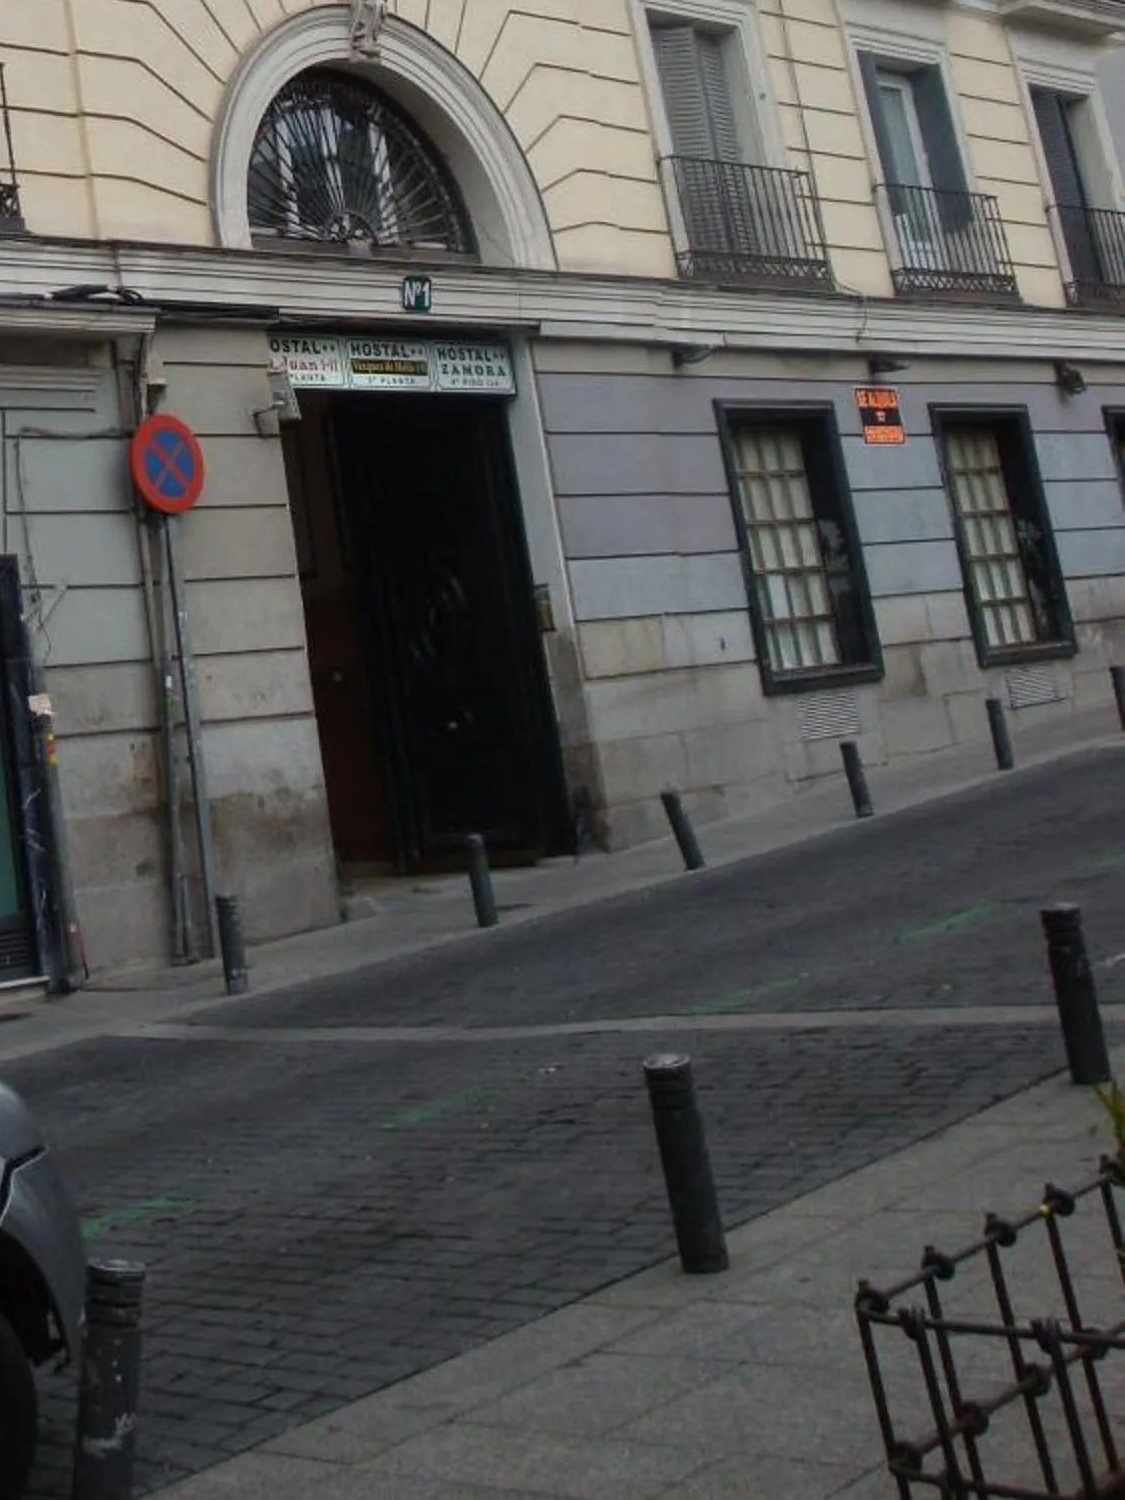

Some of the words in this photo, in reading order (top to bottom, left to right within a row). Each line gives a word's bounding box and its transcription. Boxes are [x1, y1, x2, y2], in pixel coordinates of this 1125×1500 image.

[350, 343, 410, 358] HOSTAL
[437, 347, 492, 362] HOSTAL
[441, 363, 507, 377] ZAMORA
